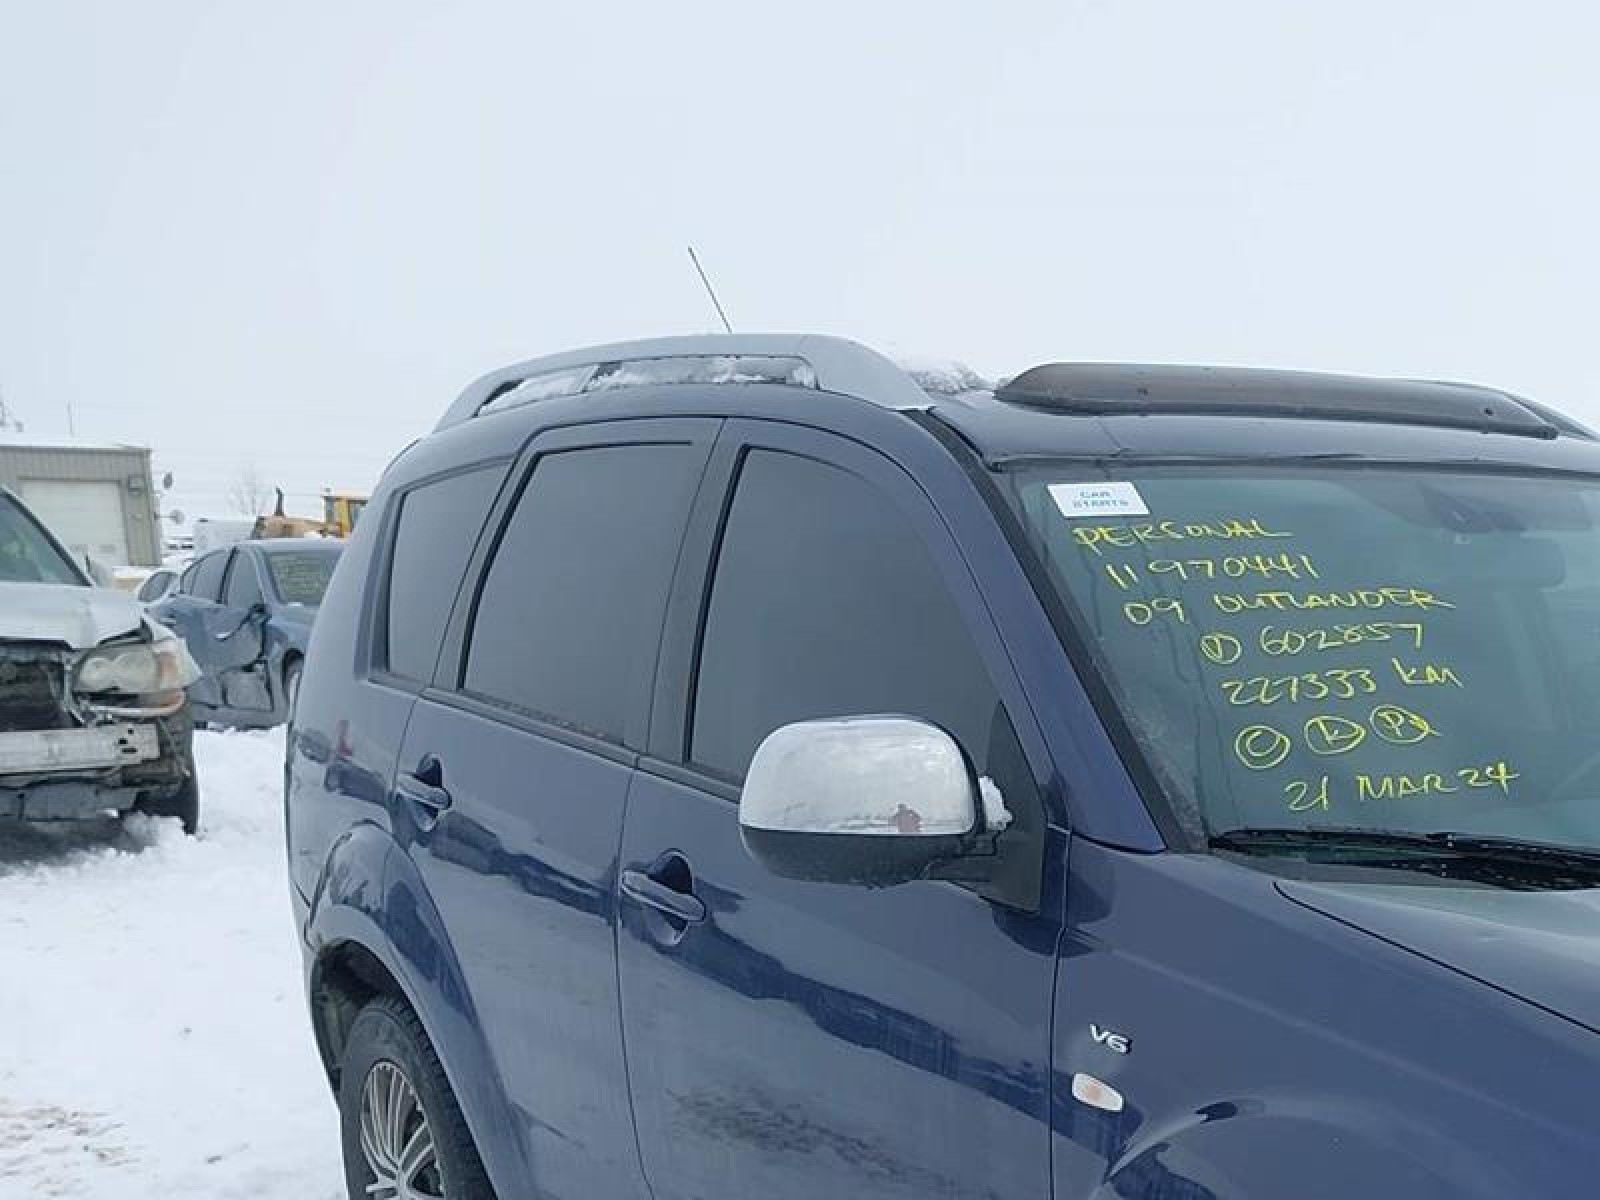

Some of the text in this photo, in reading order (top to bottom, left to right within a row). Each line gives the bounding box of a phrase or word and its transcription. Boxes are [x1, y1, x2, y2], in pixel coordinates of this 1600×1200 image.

[1071, 519, 1293, 557] PERSONAL
[1104, 552, 1320, 590] 11970441
[1122, 587, 1457, 626] 09 OUTLANDER
[1259, 621, 1423, 656] 602857
[1220, 667, 1378, 705] 227333
[1283, 761, 1521, 812] 21 MAR 24
[1088, 1023, 1129, 1054] V6
